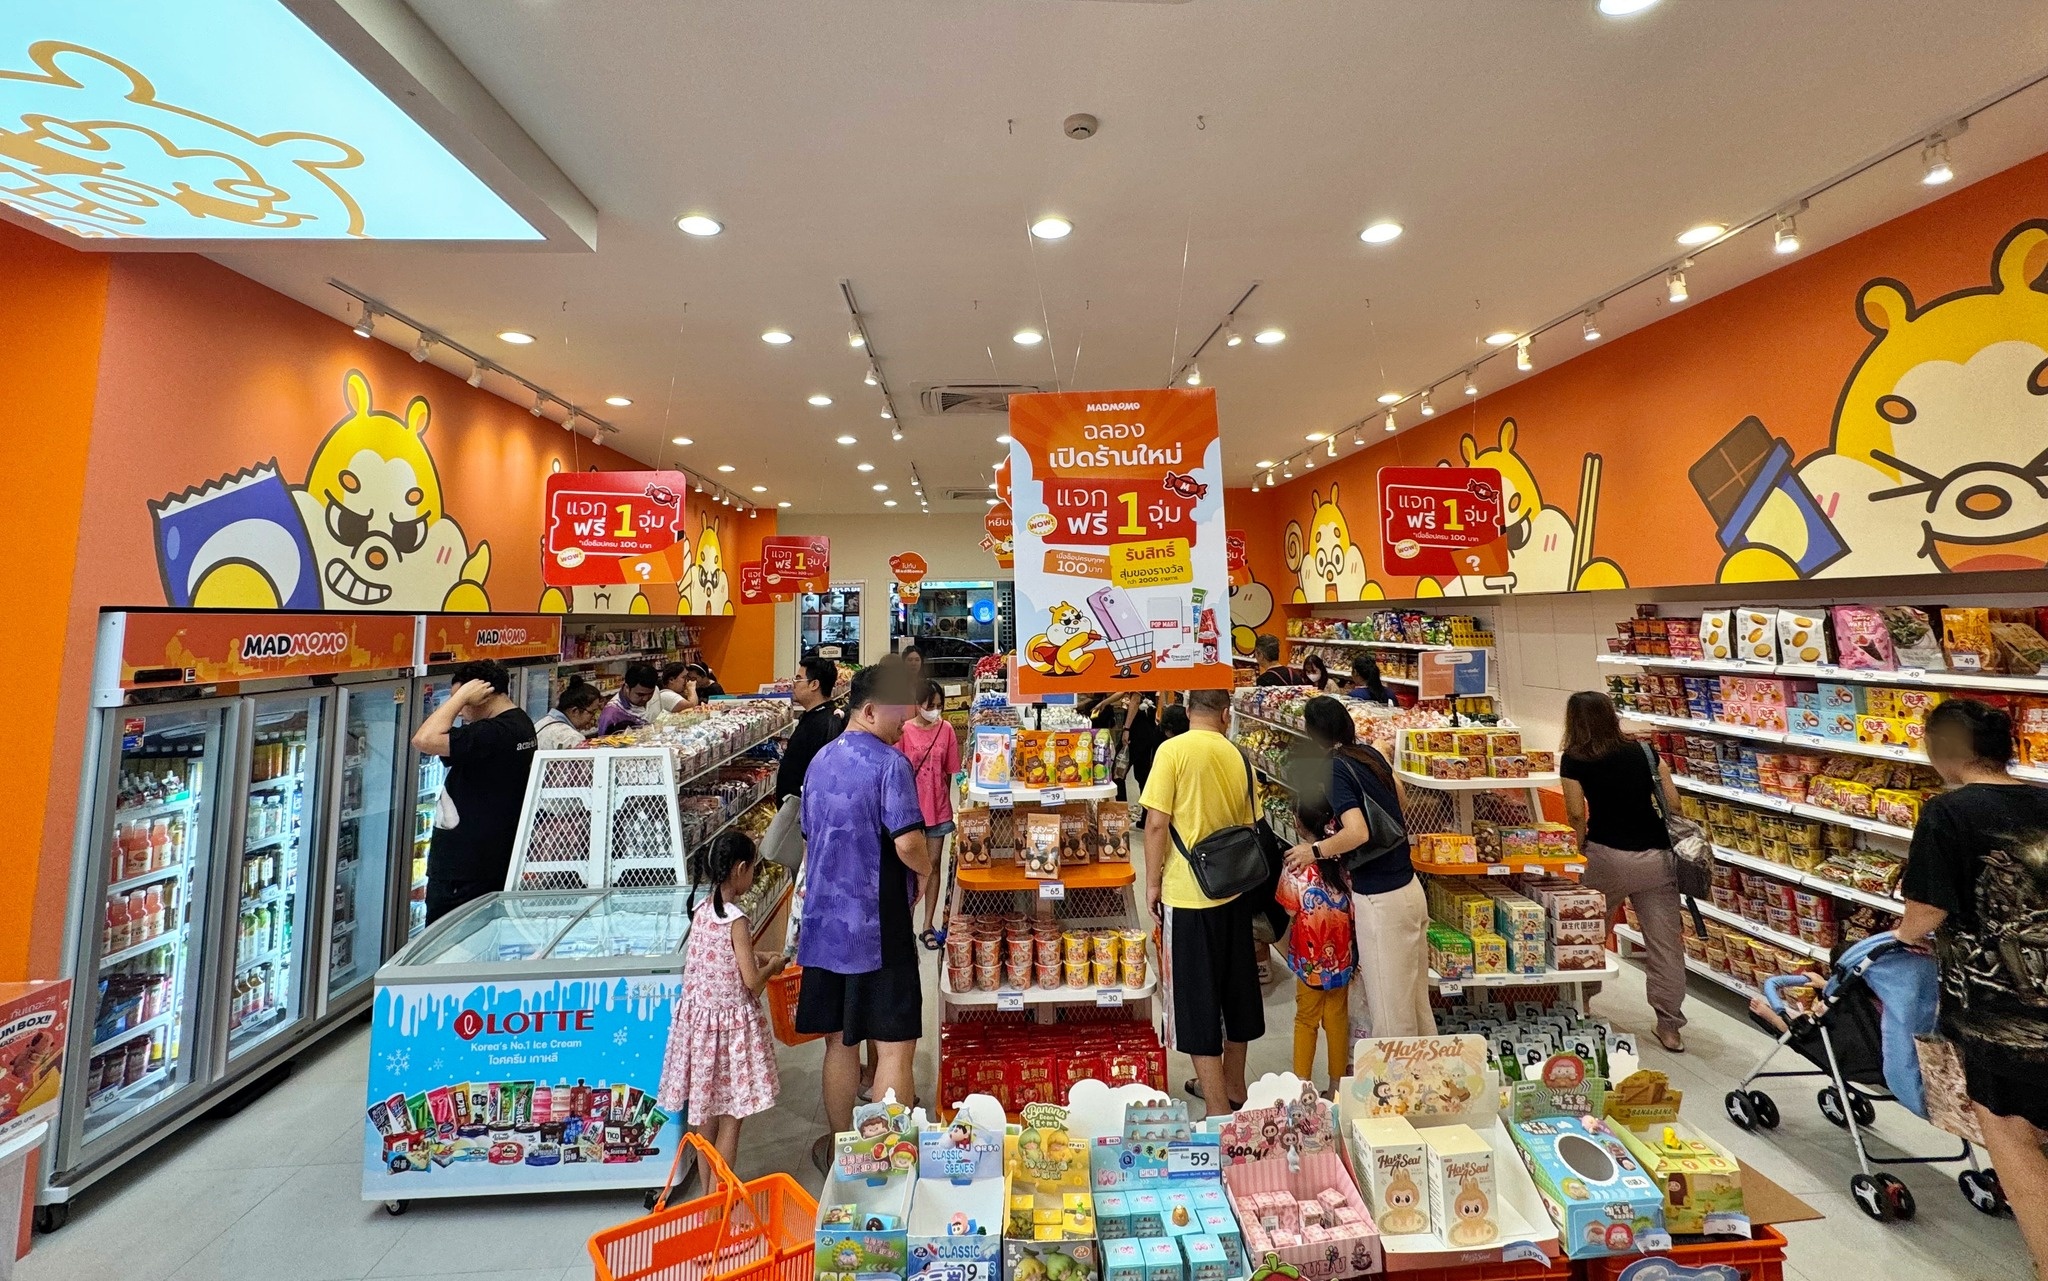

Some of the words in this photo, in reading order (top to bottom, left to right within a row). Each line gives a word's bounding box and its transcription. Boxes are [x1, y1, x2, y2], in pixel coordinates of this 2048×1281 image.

[1086, 402, 1140, 412] MADMOMO
[1083, 423, 1145, 440] ฉลอง
[1049, 442, 1182, 468] เปิดร้านใหม่
[1057, 488, 1107, 507] แจก
[1399, 495, 1435, 509] แจก
[566, 501, 607, 516] แจก
[1067, 510, 1108, 535] ฟรี
[1117, 491, 1147, 536] 1
[1148, 499, 1181, 529] จุ่ม
[1407, 511, 1436, 529] ฟรี
[1442, 499, 1464, 531] 1
[1464, 505, 1487, 527] จุ่ม
[574, 518, 606, 537] ฟรี
[613, 504, 637, 537] 1
[638, 510, 664, 533] จุ่ม
[1029, 517, 1054, 530] WOW!
[771, 550, 792, 559] แจก
[1125, 541, 1176, 562] รับสิทธิ์
[1398, 545, 1418, 554] WOW!
[561, 552, 582, 563] WOW!
[775, 559, 792, 569] ฟรี
[795, 552, 806, 570] 1
[807, 555, 820, 567] จุ่ม
[1057, 560, 1088, 574] 100
[1088, 565, 1103, 574] บาท
[1119, 564, 1184, 581] สุ่มของรางวัล
[1162, 620, 1177, 628] MART
[475, 627, 527, 646] MADMOMO
[242, 631, 348, 659] MADMOMO
[1964, 657, 1975, 665] 49
[1904, 695, 1925, 706] 泡芙
[1050, 887, 1060, 896] 65
[1449, 983, 1459, 991] 30
[1008, 998, 1018, 1006] 30
[1108, 994, 1118, 1002] 30
[486, 1009, 595, 1035] LOTTE
[470, 1042, 507, 1052] Korea's
[510, 1041, 530, 1051] No.1
[533, 1040, 547, 1050] Ice
[550, 1039, 582, 1049] Cream
[1382, 1038, 1428, 1063] Have
[1426, 1041, 1465, 1062] Seat
[530, 1051, 558, 1064] เกาหลี
[1026, 1104, 1066, 1120] Banana
[607, 1131, 619, 1140] TICO
[931, 1150, 963, 1160] CLASSIC
[1191, 1152, 1210, 1166] 59
[1377, 1153, 1402, 1169] Have
[1399, 1155, 1421, 1168] Seat
[944, 1163, 975, 1174] SCENES
[1446, 1162, 1471, 1178] Have
[1468, 1163, 1490, 1177] Seat
[1726, 1224, 1737, 1232] 39
[1650, 1239, 1660, 1248] 39
[938, 1245, 980, 1259] CLASSIC
[1522, 1249, 1543, 1262] 1390
